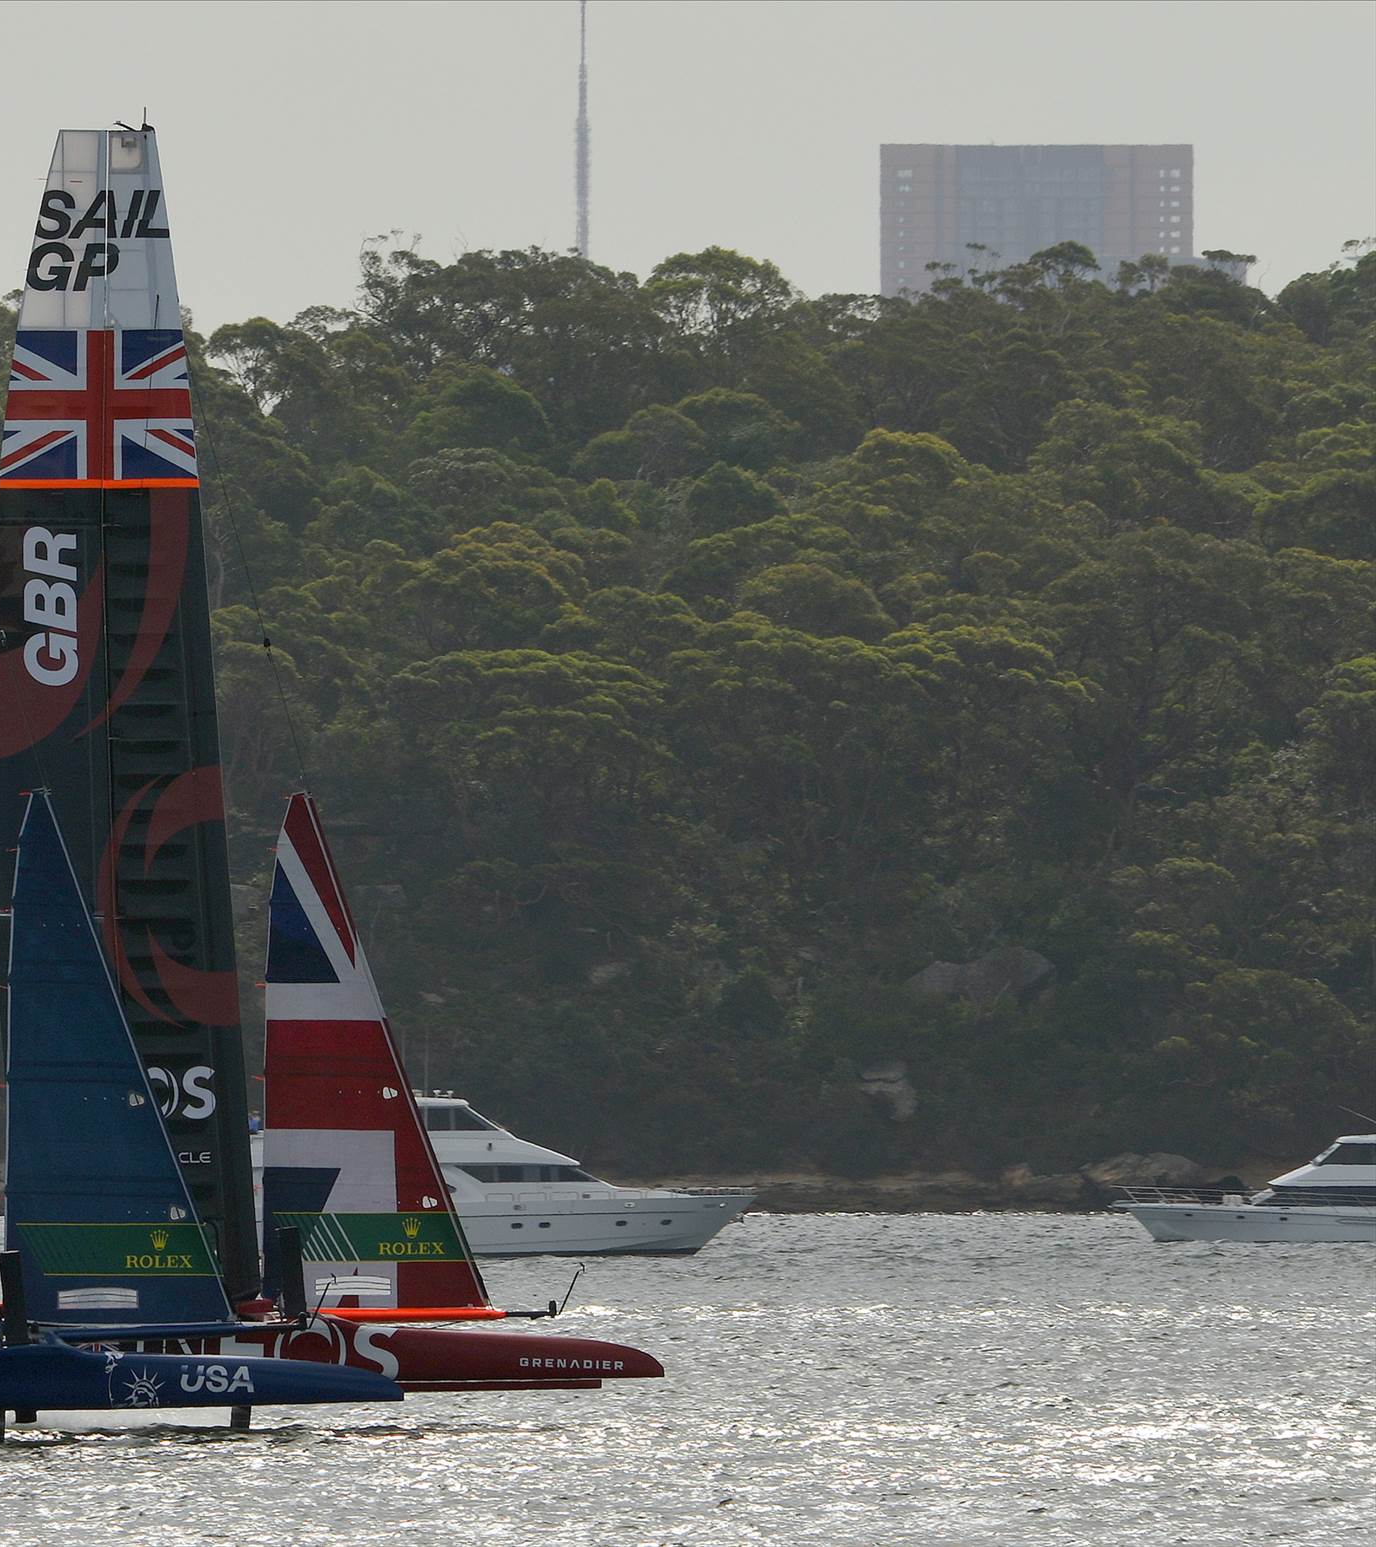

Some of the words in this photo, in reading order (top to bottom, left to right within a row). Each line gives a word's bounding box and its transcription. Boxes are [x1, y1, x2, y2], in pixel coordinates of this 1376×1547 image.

[34, 190, 170, 240] SAIL
[26, 242, 120, 291] GP
[23, 526, 79, 687] GBR
[126, 1255, 193, 1269] ROLEX
[378, 1242, 446, 1255] ROLEX
[519, 1357, 624, 1371] GRENADIER
[180, 1365, 255, 1394] USA
